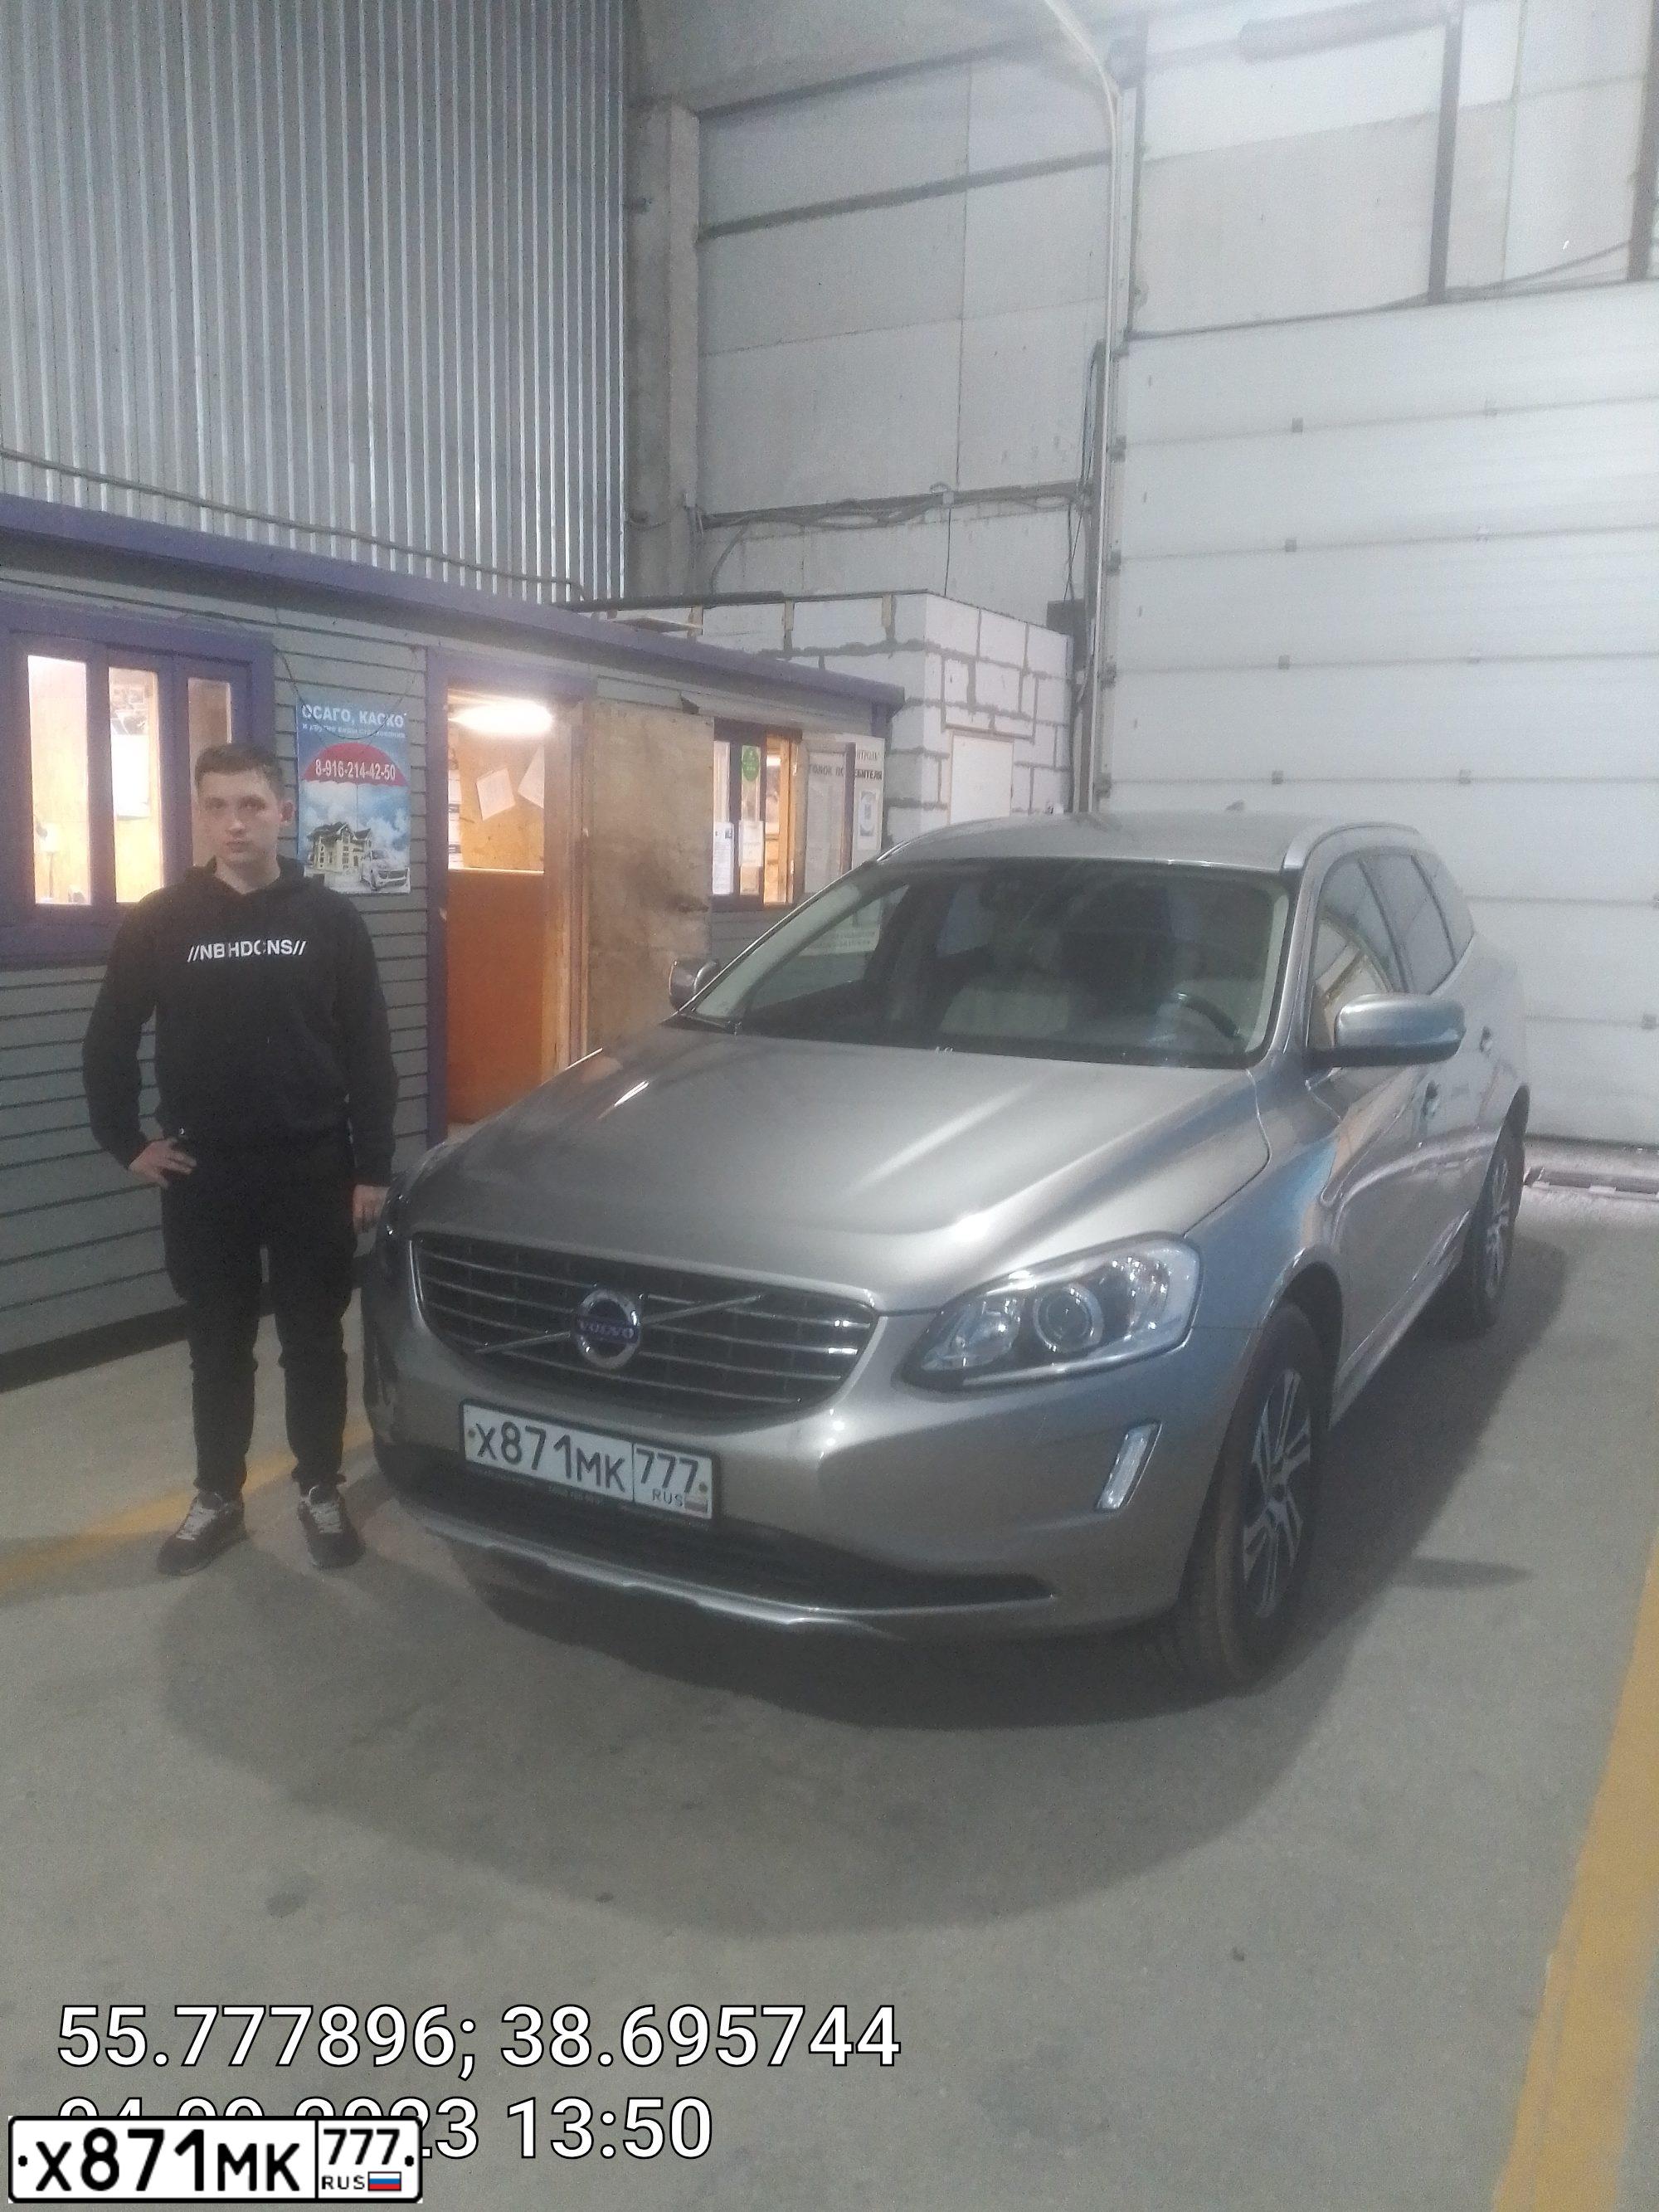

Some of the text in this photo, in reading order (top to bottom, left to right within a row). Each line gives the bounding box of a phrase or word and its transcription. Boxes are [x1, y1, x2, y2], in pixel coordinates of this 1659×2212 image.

[359, 709, 404, 728] КАСКО
[314, 758, 396, 781] 8-916-214-42-50
[636, 1448, 698, 1493] 777
[652, 1488, 684, 1508] RUS
